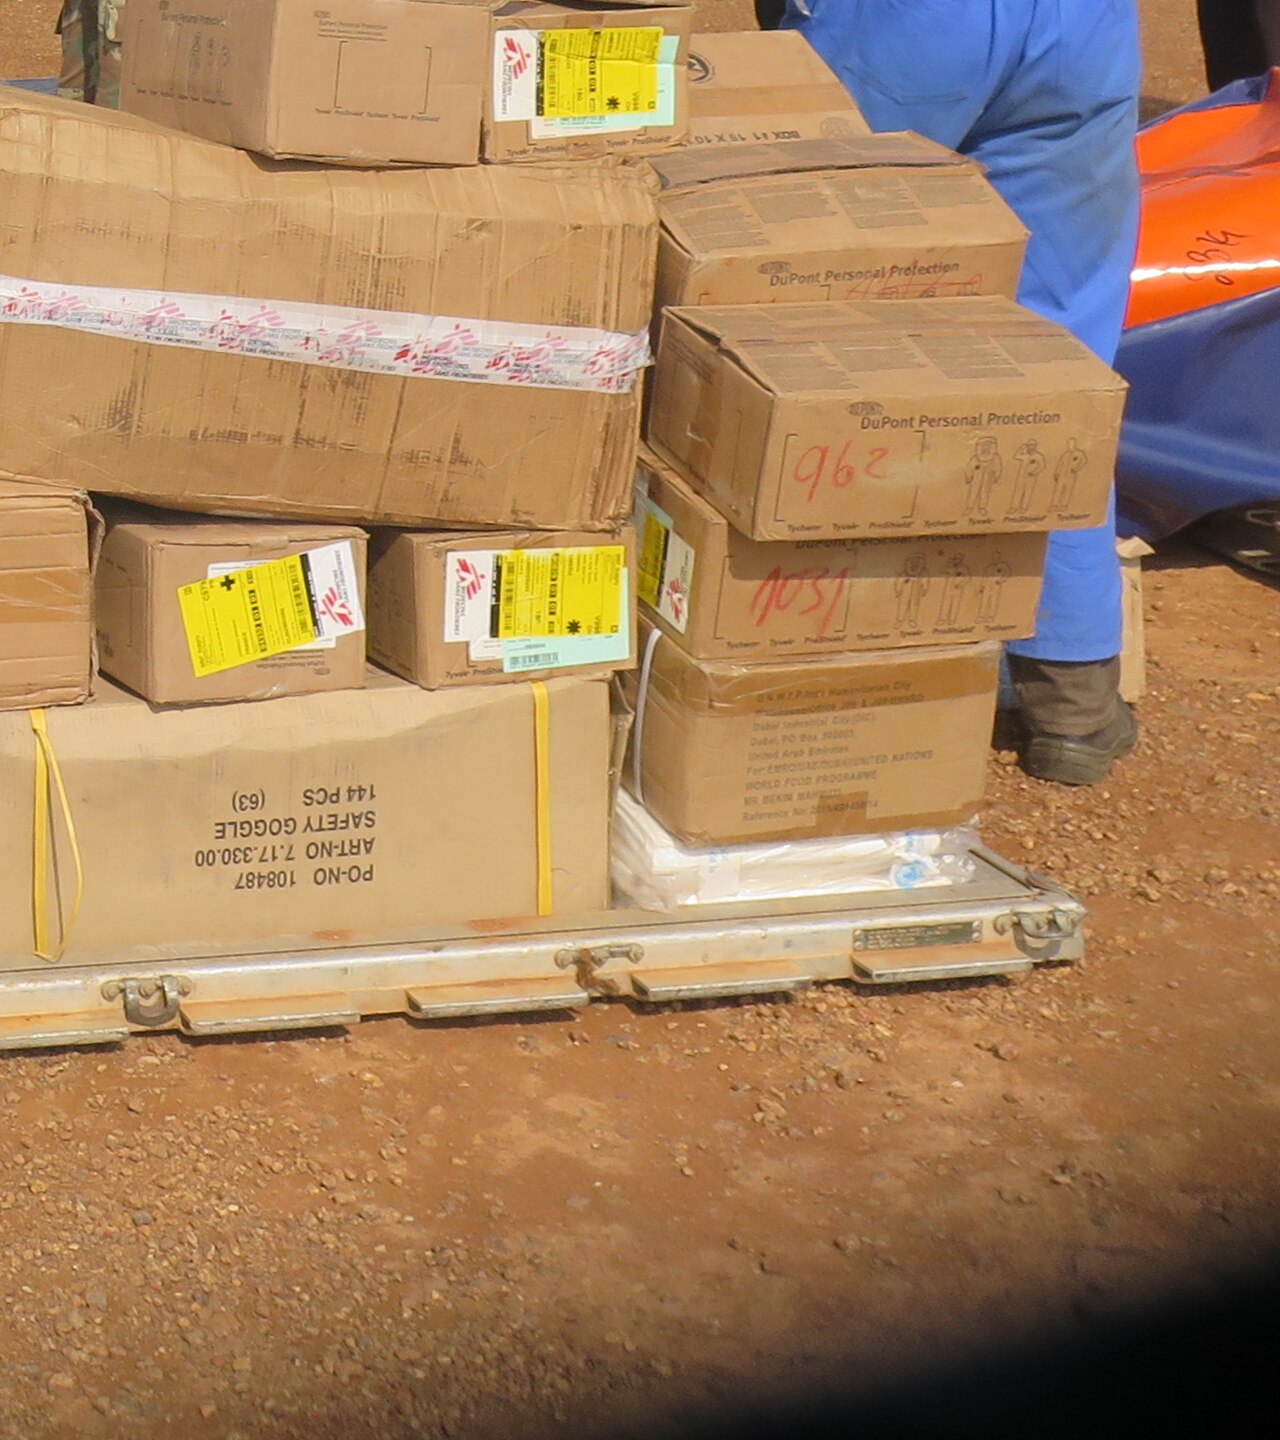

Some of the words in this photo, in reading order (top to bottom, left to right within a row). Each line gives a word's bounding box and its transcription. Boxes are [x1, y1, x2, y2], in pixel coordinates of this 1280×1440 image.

[770, 272, 820, 287] DuPont
[861, 417, 915, 430] DuPont
[919, 414, 983, 428] Personal
[988, 411, 1061, 426] Protection
[231, 787, 266, 813] (63)
[302, 786, 341, 806] PCS
[346, 783, 377, 802] 144
[213, 817, 297, 840] GOGGLE
[302, 810, 376, 834] SAFETY
[194, 843, 296, 868] 7.17.330.00
[305, 837, 376, 860] ART-NO
[234, 870, 296, 890] 108487
[313, 863, 374, 886] PO-NO
